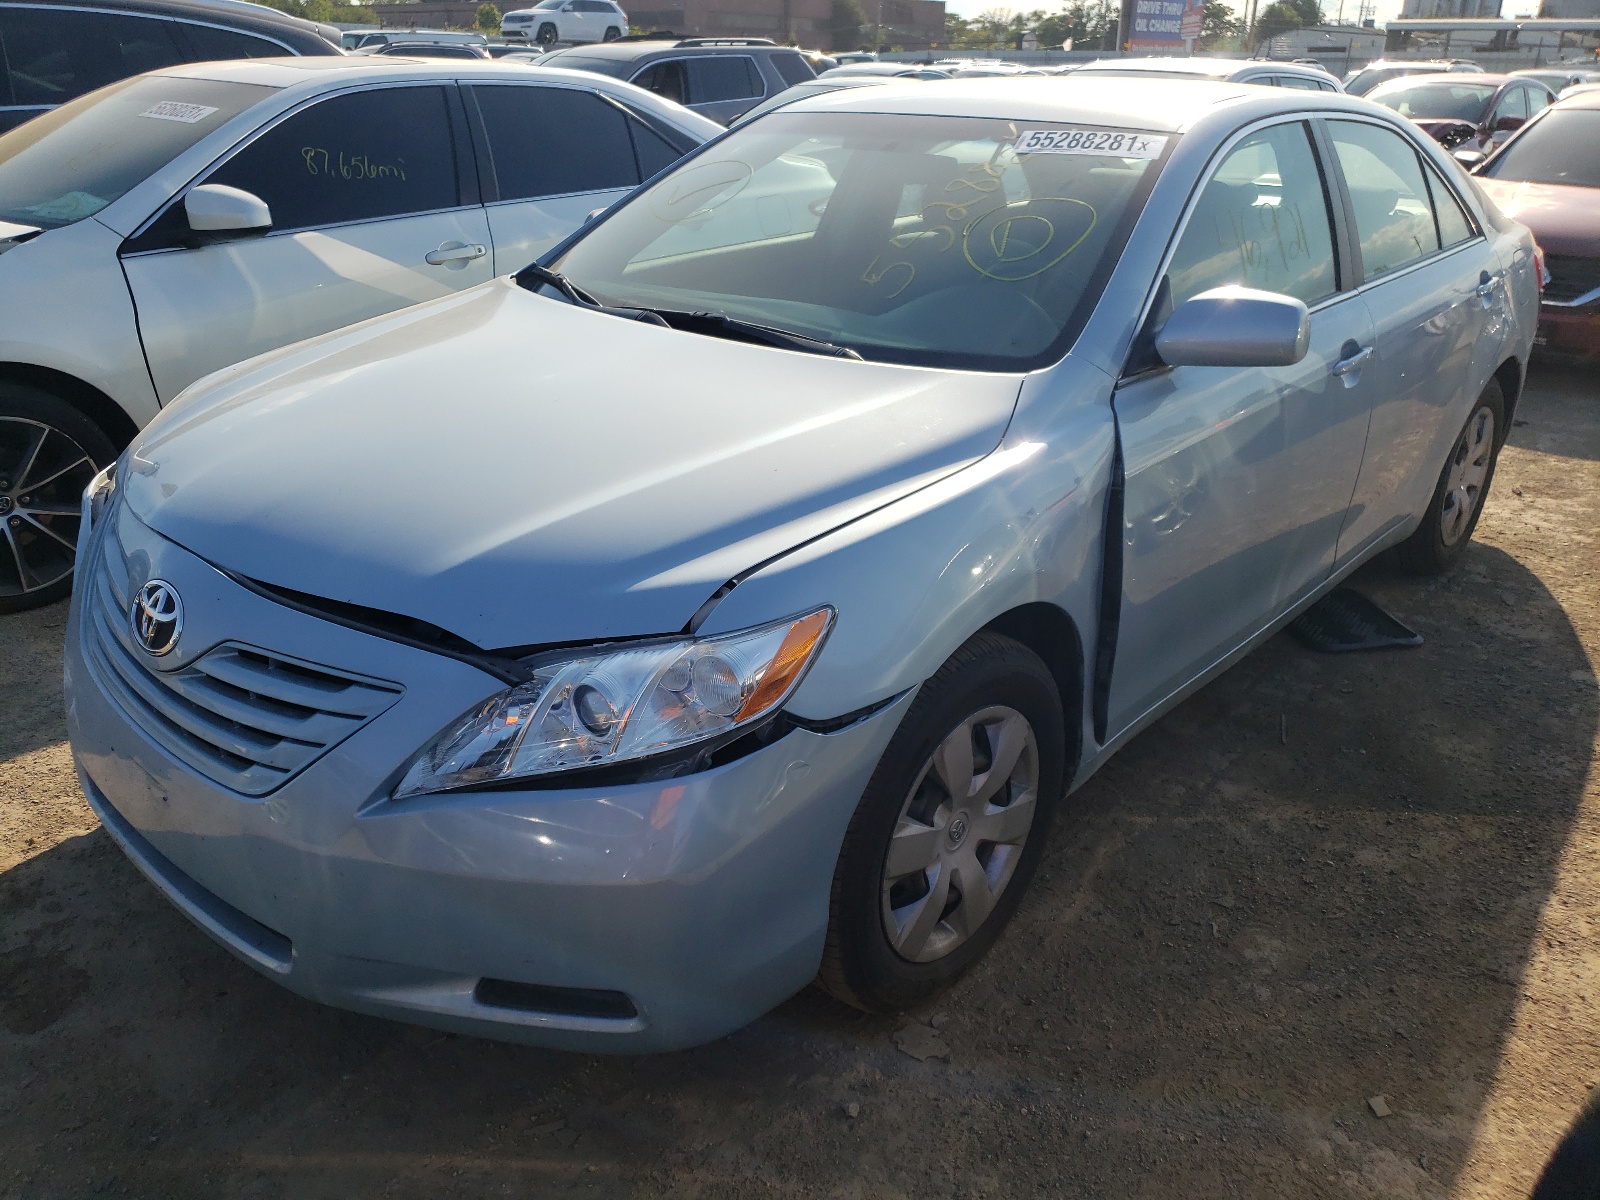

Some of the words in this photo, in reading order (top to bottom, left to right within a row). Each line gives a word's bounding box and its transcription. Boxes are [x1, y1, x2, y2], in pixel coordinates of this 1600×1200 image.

[1136, 1, 1161, 15] DRIVE
[1162, 2, 1183, 16] THRU
[1134, 18, 1147, 32] OIL
[1148, 19, 1181, 33] CHANGE
